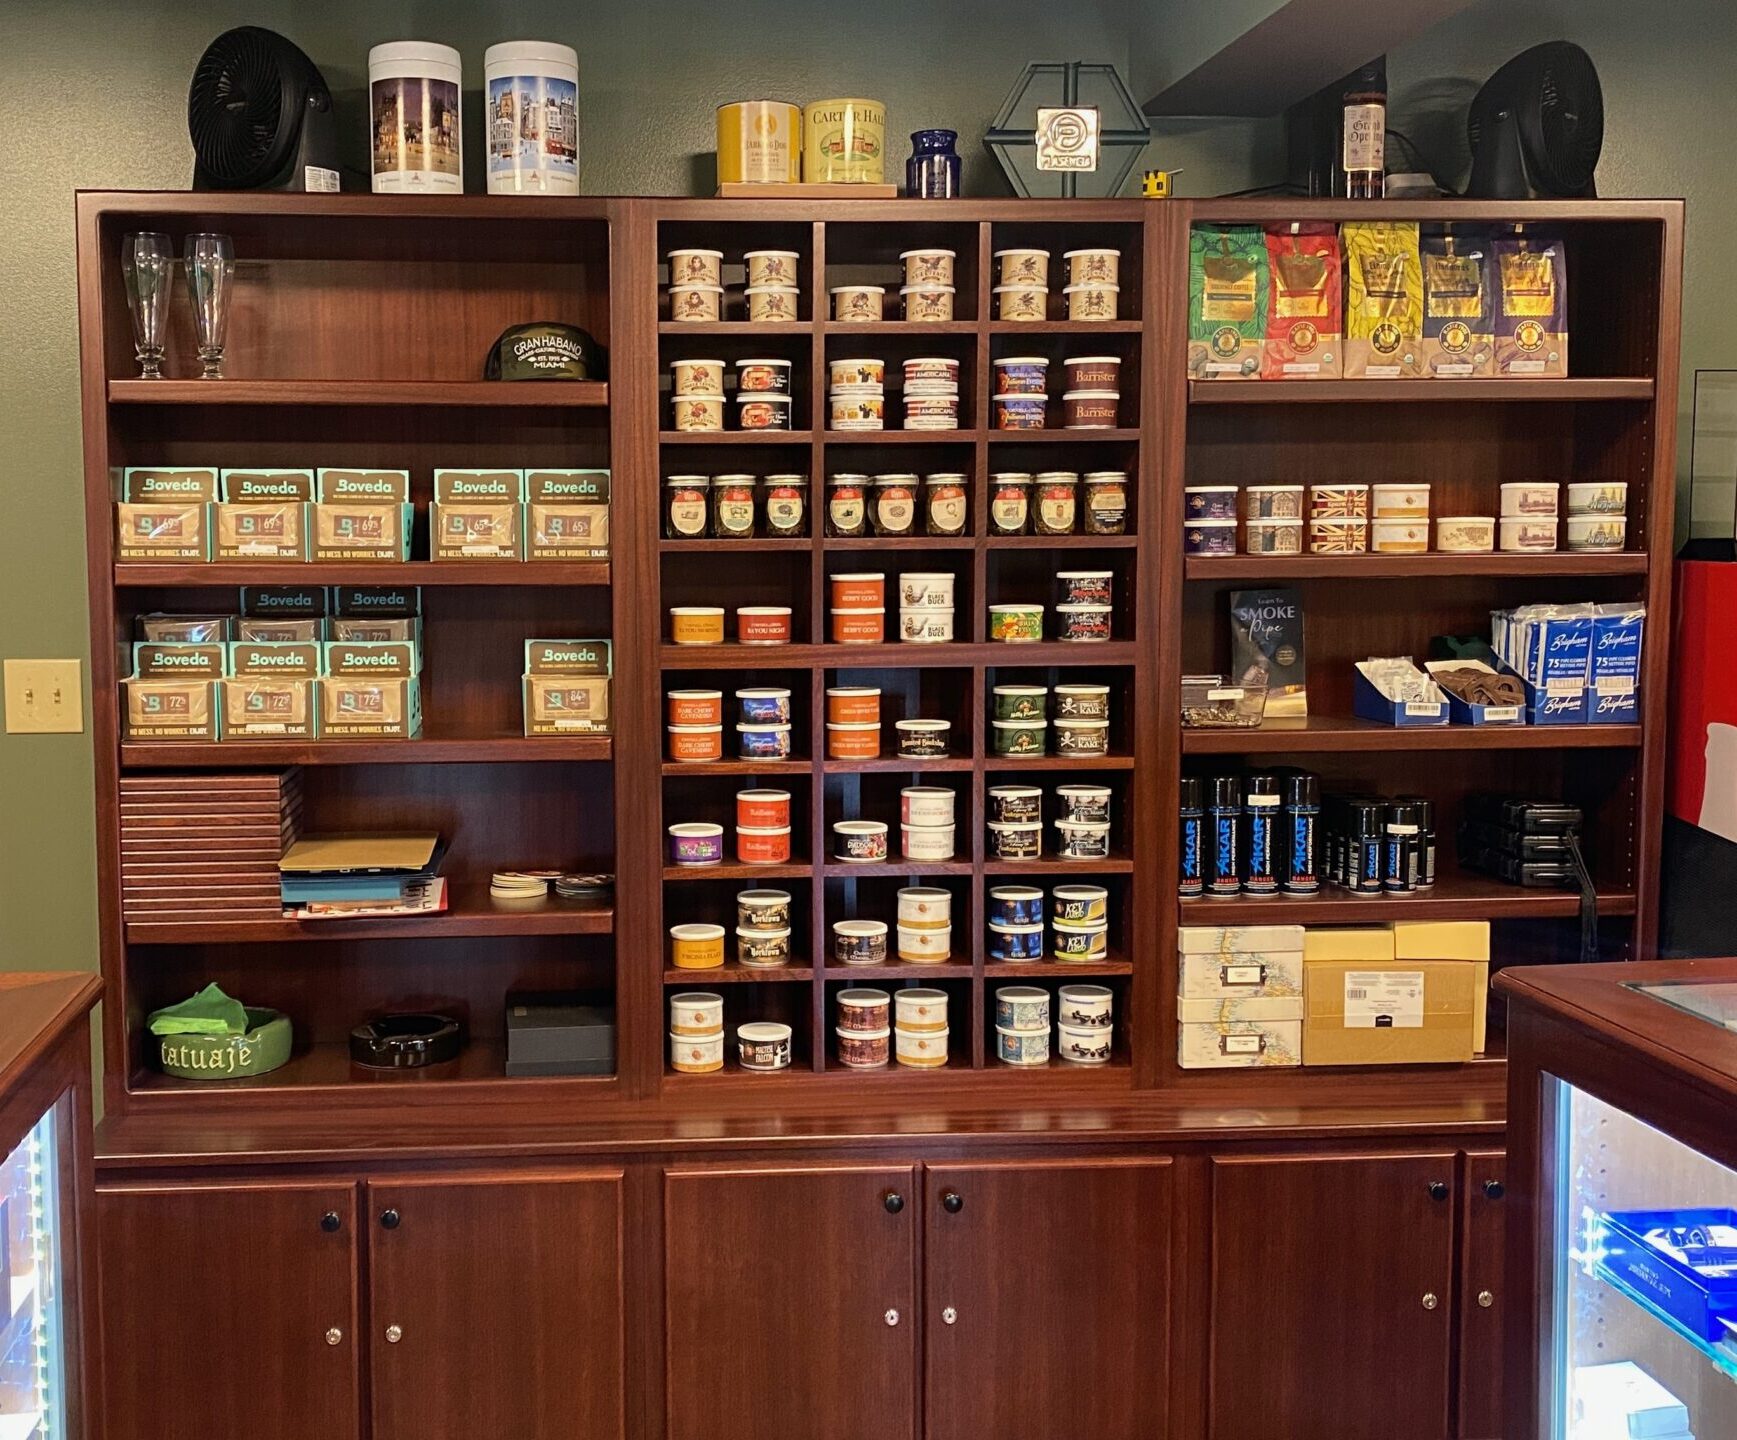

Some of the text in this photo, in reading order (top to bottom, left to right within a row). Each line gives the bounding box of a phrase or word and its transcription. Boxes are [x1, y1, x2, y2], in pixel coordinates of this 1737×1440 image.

[812, 109, 862, 124] CARTR
[1041, 155, 1092, 168] PLASENCIA
[514, 336, 582, 356] GRAN HABANO
[142, 478, 200, 491] Boveda
[240, 480, 297, 494] Boveda
[336, 478, 392, 493] Boveda
[451, 480, 506, 494] Boveda
[541, 480, 597, 494] Boveda
[257, 592, 312, 606] Boveda
[351, 592, 404, 605] Boveda
[1240, 606, 1295, 620] SMOKE
[1248, 618, 1284, 642] Pipe
[1550, 632, 1588, 652] Brigham
[1598, 630, 1636, 650] Brigham
[152, 652, 209, 666] Boveda
[248, 652, 304, 666] Boveda
[342, 652, 398, 666] Boveda
[541, 648, 596, 662] Boveda
[1596, 657, 1608, 667] 75
[1548, 658, 1559, 668] 75
[1544, 696, 1581, 714] Brigham
[1597, 695, 1635, 713] Brigham
[1065, 902, 1085, 913] KEY
[1068, 935, 1087, 947] KEY
[161, 1042, 252, 1072] tatuaje
